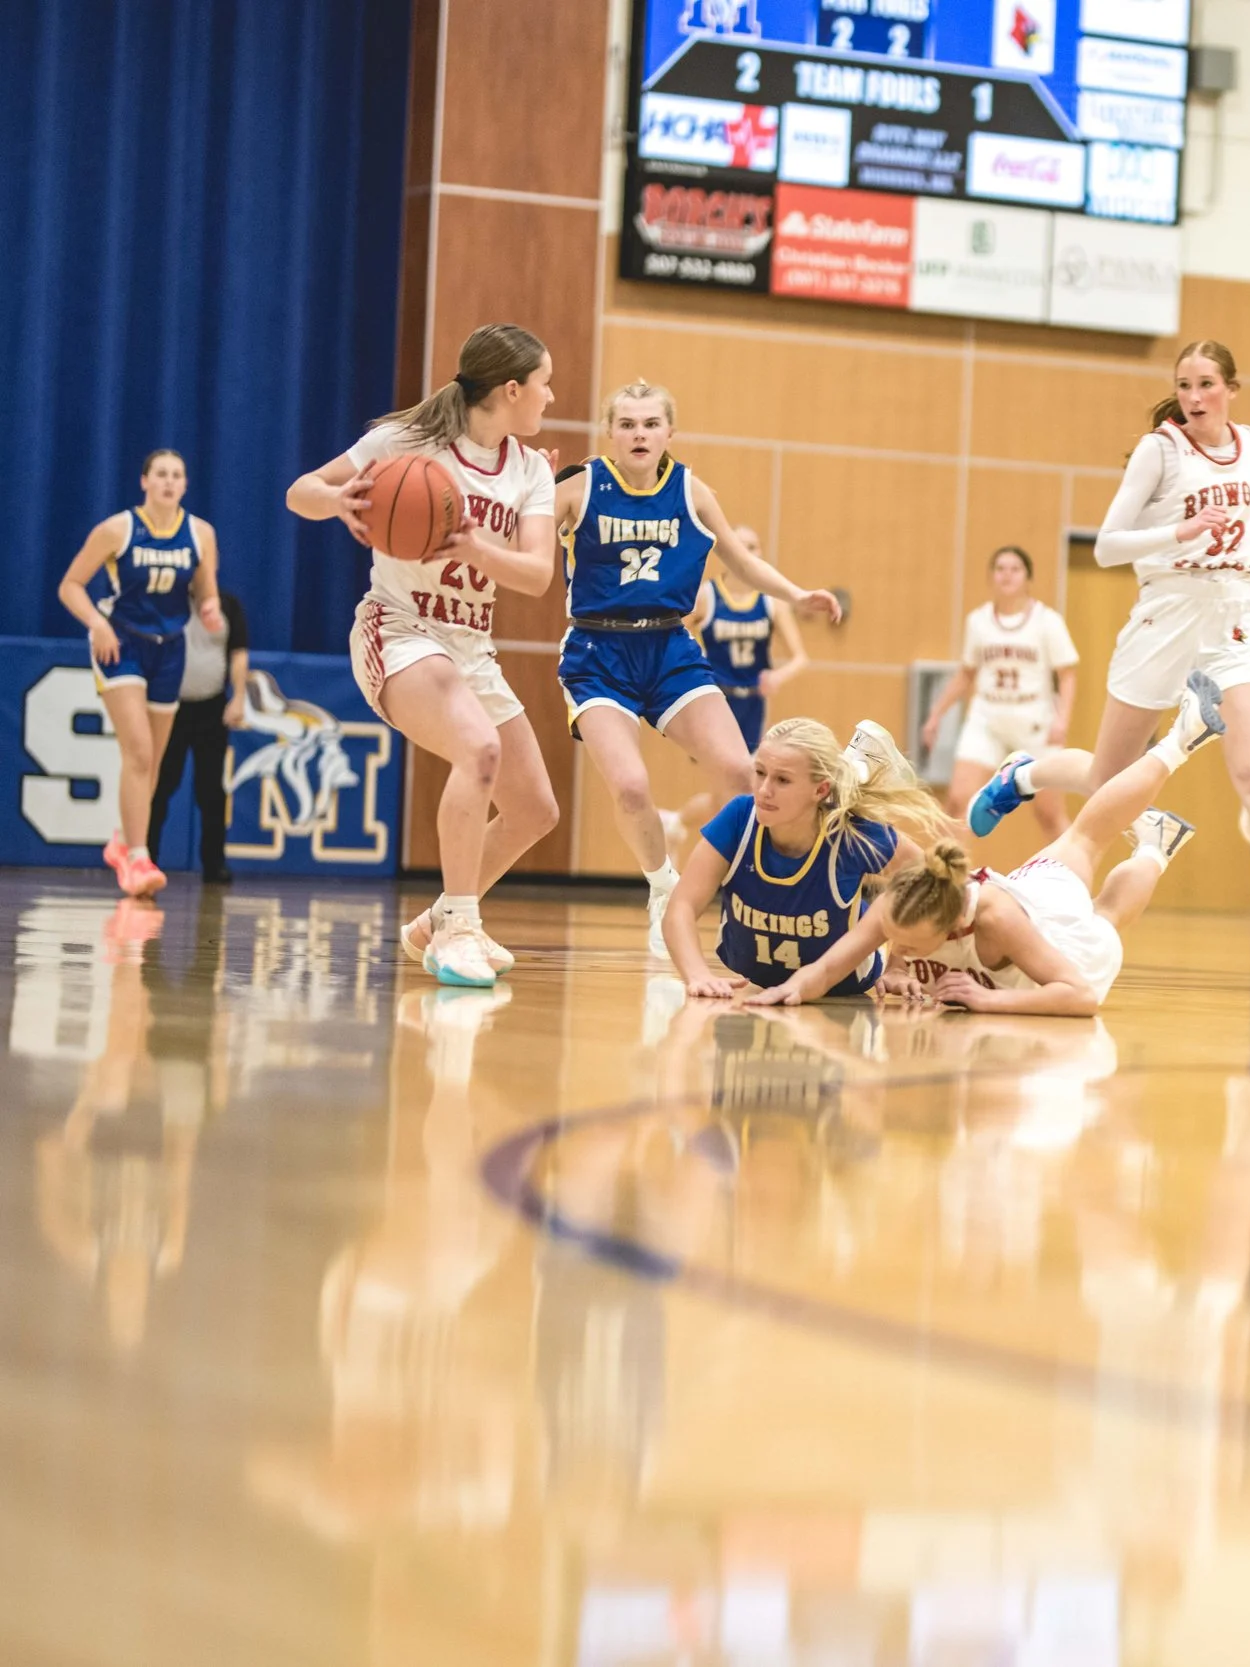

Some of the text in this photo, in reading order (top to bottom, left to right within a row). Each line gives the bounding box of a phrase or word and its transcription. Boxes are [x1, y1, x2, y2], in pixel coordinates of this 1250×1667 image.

[735, 51, 762, 93] 2
[794, 61, 941, 114] TEAM FOULS
[971, 82, 993, 122] 1
[598, 515, 680, 547] VIKINGS
[1205, 520, 1245, 556] 32
[132, 546, 191, 569] VIKINGS
[620, 546, 662, 586] 22
[146, 567, 176, 593] 10
[411, 591, 493, 631] VALLE
[732, 893, 829, 938] VIKINGS
[754, 934, 800, 969] 14
